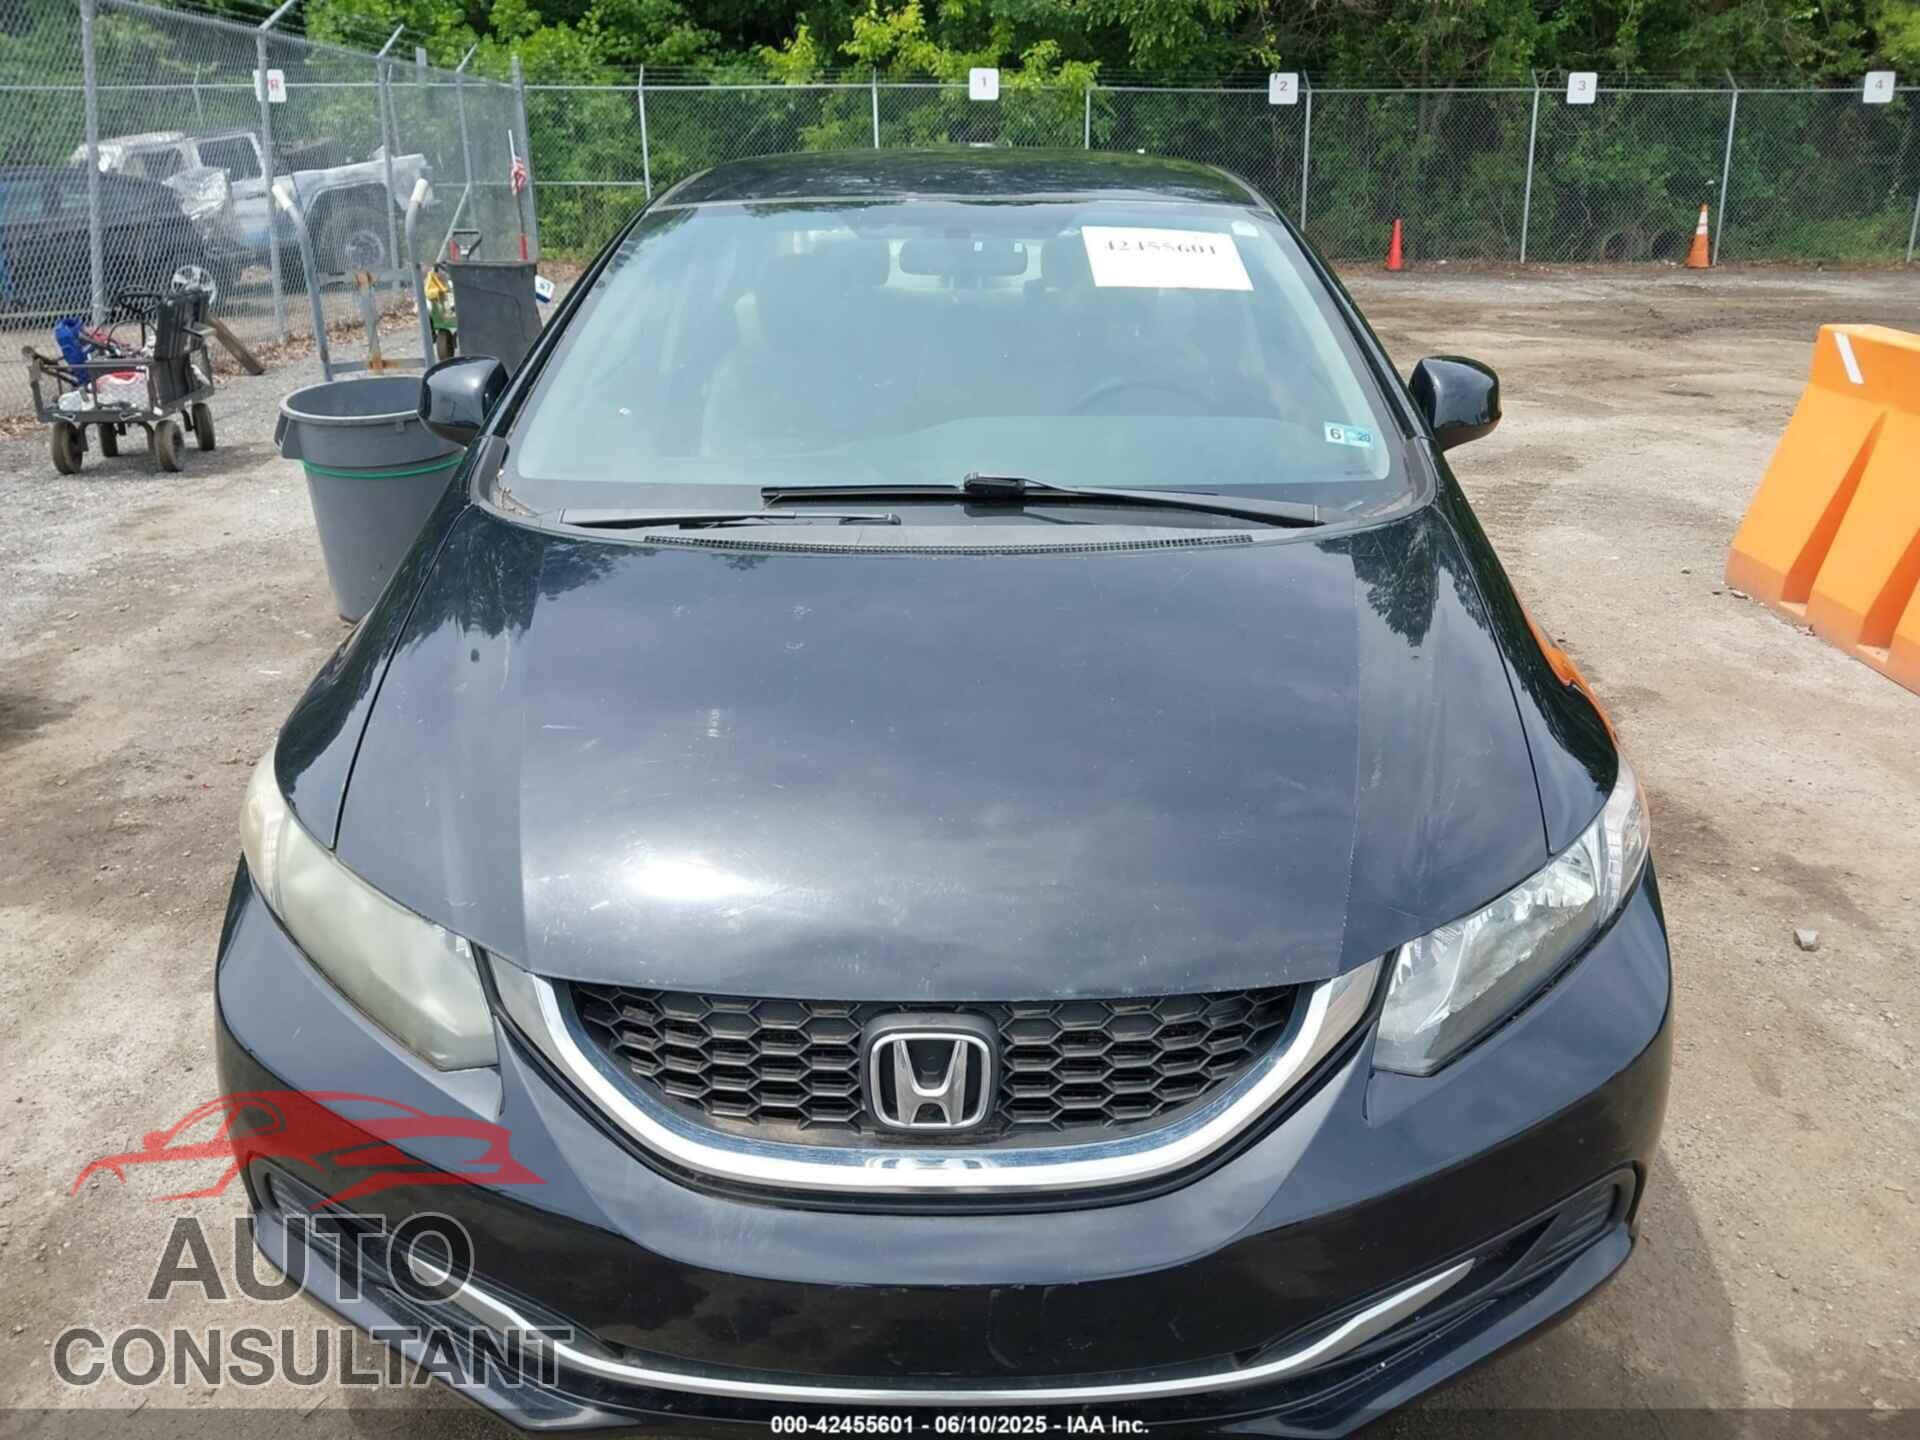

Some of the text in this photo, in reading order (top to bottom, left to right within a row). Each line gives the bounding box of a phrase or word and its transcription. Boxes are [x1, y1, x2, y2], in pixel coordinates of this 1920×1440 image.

[1279, 80, 1288, 91] 2
[1577, 80, 1586, 91] 3
[1874, 79, 1884, 90] 4
[1330, 428, 1342, 440] 6
